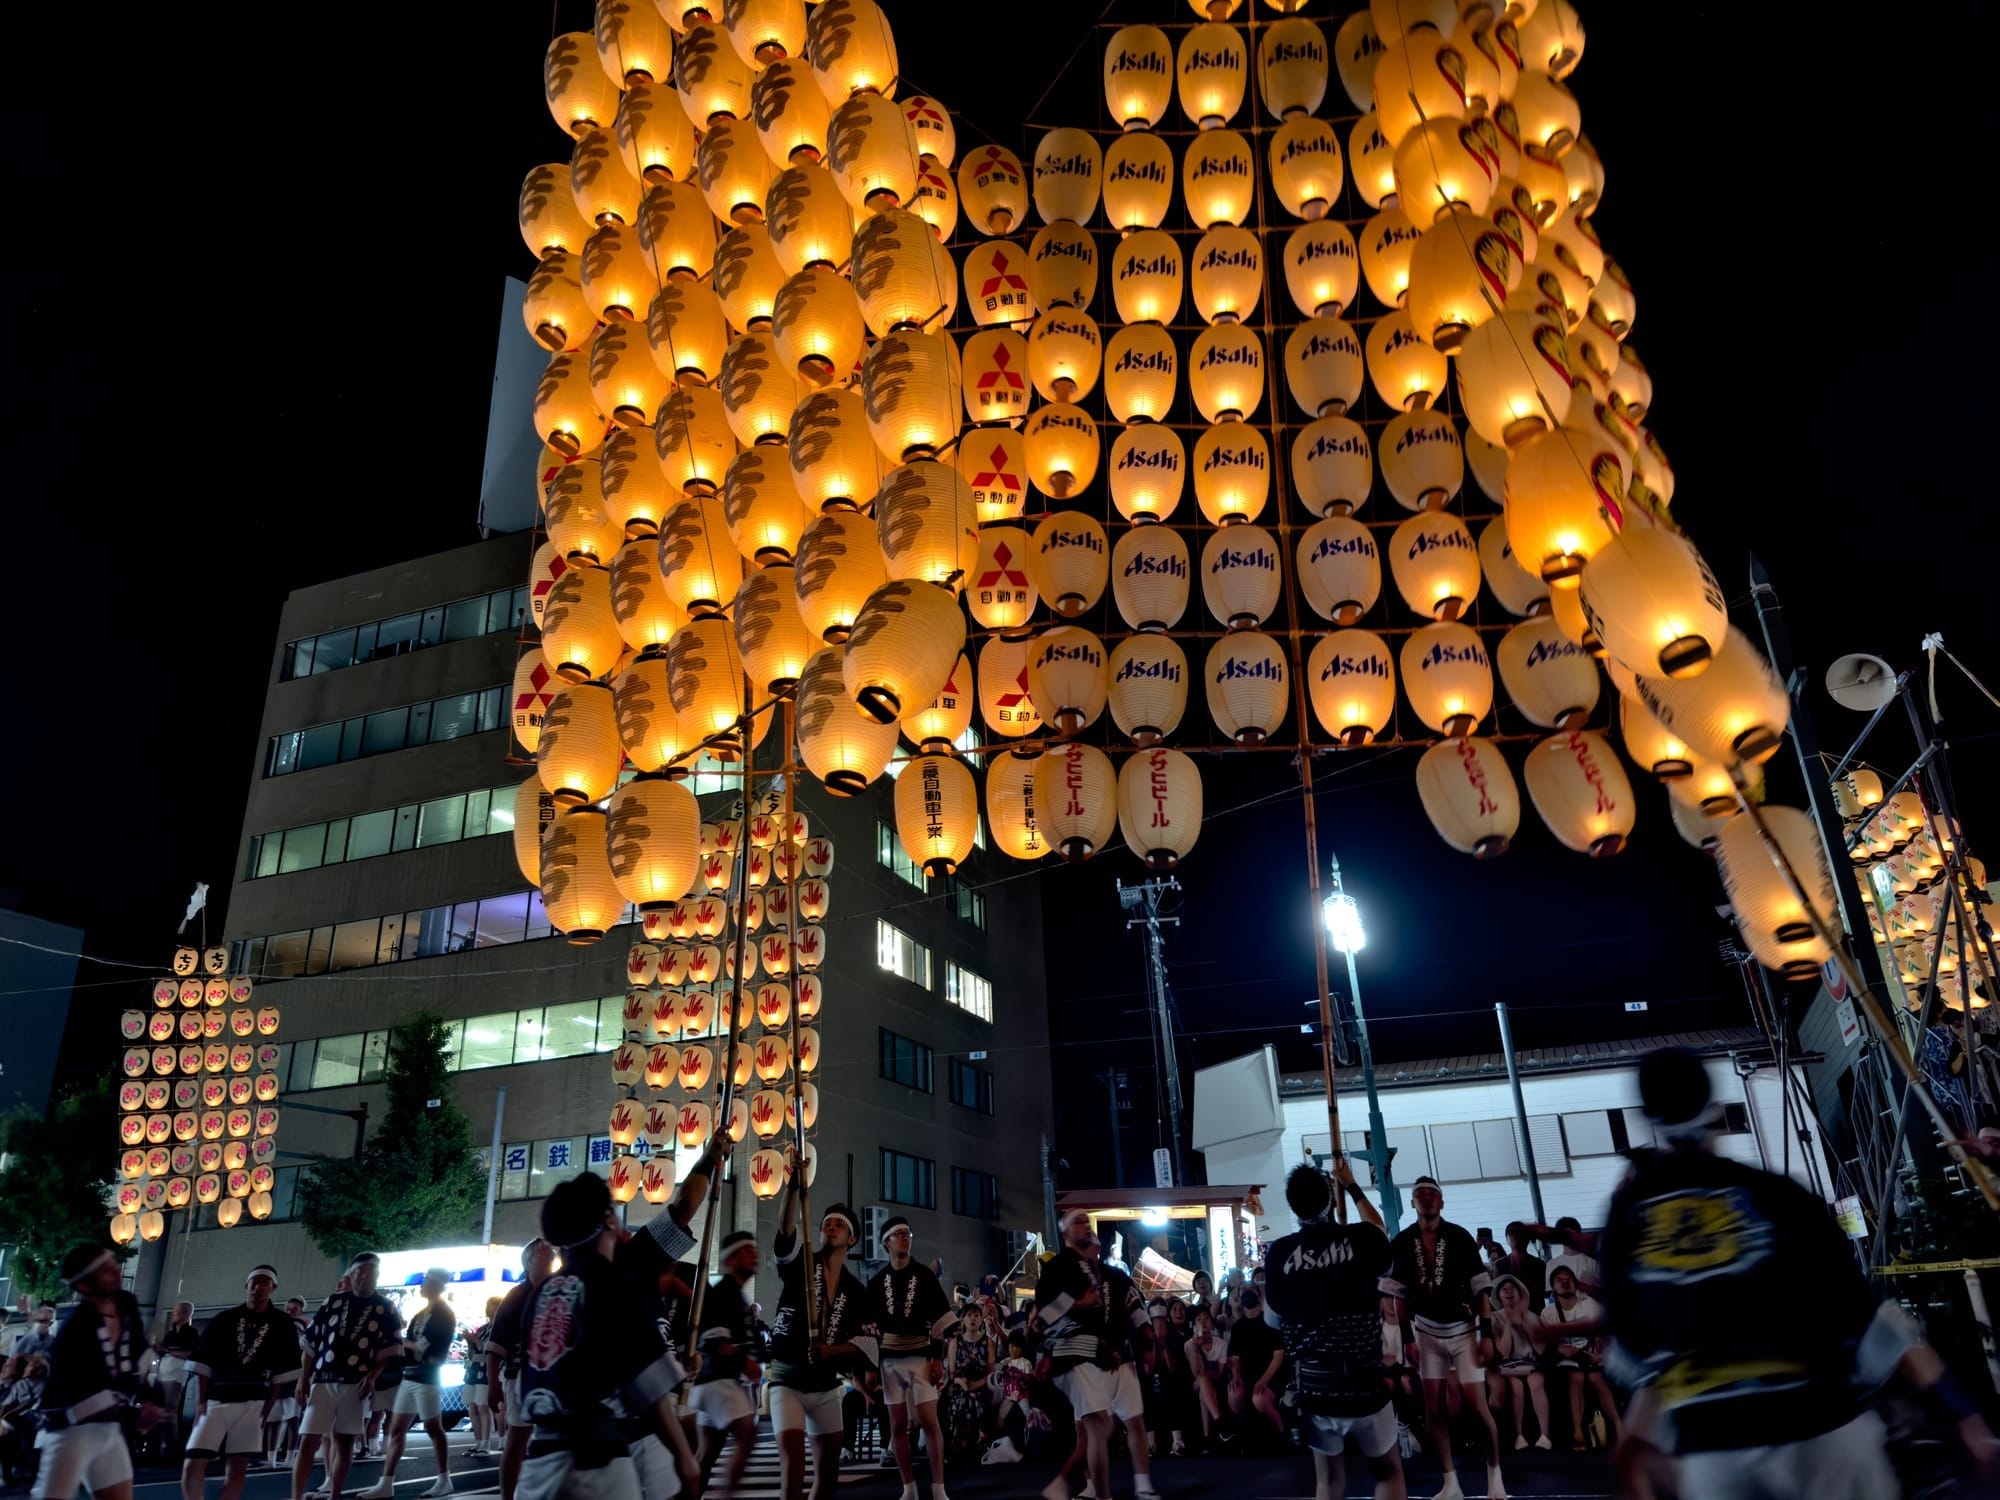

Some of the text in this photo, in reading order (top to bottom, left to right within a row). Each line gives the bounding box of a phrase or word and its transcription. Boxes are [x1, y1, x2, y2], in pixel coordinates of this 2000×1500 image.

[1111, 50, 1166, 75] Asahi
[1185, 48, 1240, 75] Asahi
[1268, 41, 1323, 67] Asahi
[1281, 136, 1336, 164] Asahi
[1036, 154, 1092, 178] Asahi
[1110, 159, 1166, 184] Asahi
[1193, 155, 1248, 181] Asahi
[1036, 238, 1093, 265] Asahi
[1200, 248, 1257, 271] Asahi
[1298, 240, 1354, 266] Asahi
[1120, 254, 1177, 281] Asahi
[1038, 319, 1097, 346] Asahi
[1200, 345, 1258, 370] Asahi
[1302, 335, 1360, 360] Asahi
[1115, 348, 1172, 374] Asahi
[1032, 414, 1093, 438] Asahi
[1396, 425, 1459, 453] Asahi
[1118, 447, 1178, 472] Asahi
[1204, 446, 1265, 472] Asahi
[1308, 436, 1368, 461] Asahi
[974, 491, 1018, 504] 自動車
[1041, 529, 1103, 554] Asahi
[1311, 535, 1375, 563] Asahi
[1409, 530, 1475, 560] Asahi
[1125, 551, 1186, 579] Asahi
[1212, 548, 1275, 573] Asahi
[1037, 643, 1100, 668] Asahi
[1321, 654, 1389, 682] Asahi
[1422, 642, 1490, 671] Asahi
[1116, 657, 1181, 683] Asahi
[1216, 656, 1282, 684] Asahi
[516, 713, 543, 728] 自動
[922, 760, 944, 839] 三菱自動車工業
[1283, 1237, 1354, 1275] Asahi
